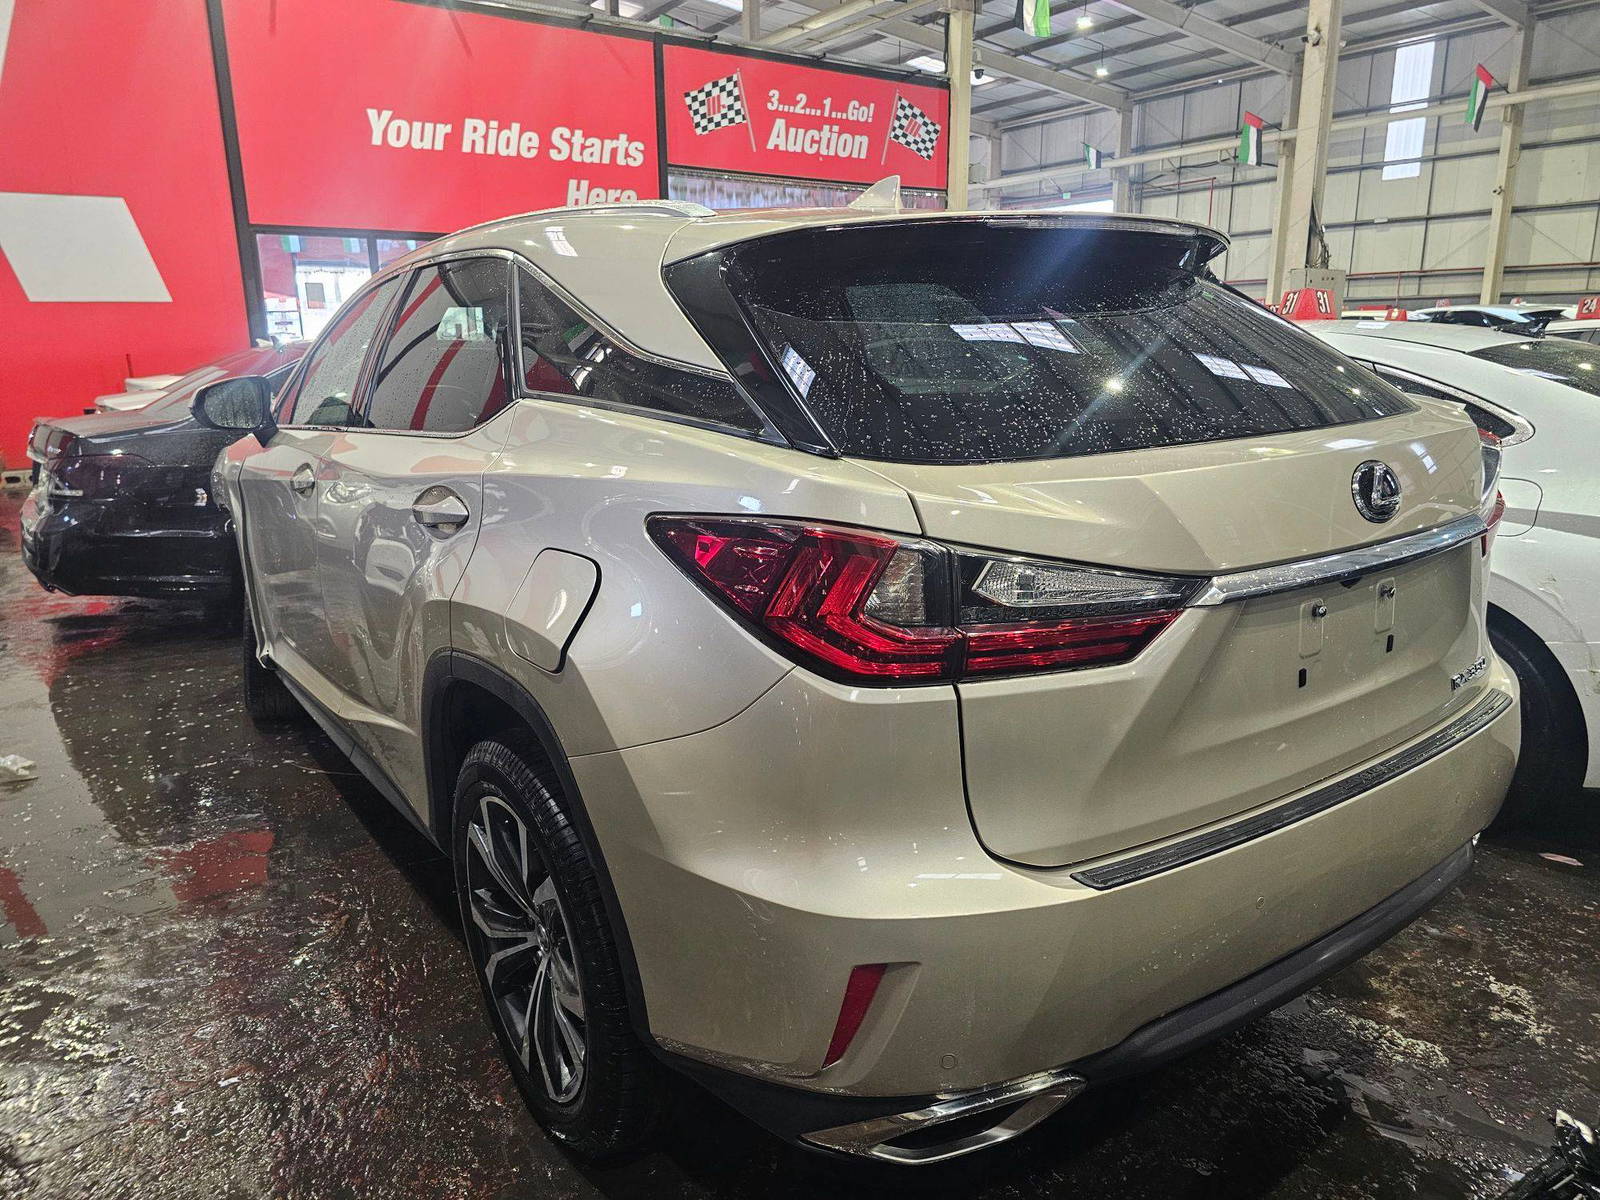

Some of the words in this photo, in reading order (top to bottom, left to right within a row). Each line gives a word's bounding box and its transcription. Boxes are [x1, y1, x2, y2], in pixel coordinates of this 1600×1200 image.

[767, 89, 875, 123] 3...2...1...Go!
[366, 108, 452, 151] Your
[462, 118, 540, 159] Ride
[549, 126, 645, 168] Starts
[766, 118, 869, 159] Auction
[1281, 291, 1299, 315] 31
[1316, 291, 1331, 314] 31
[1582, 298, 1599, 313] 24
